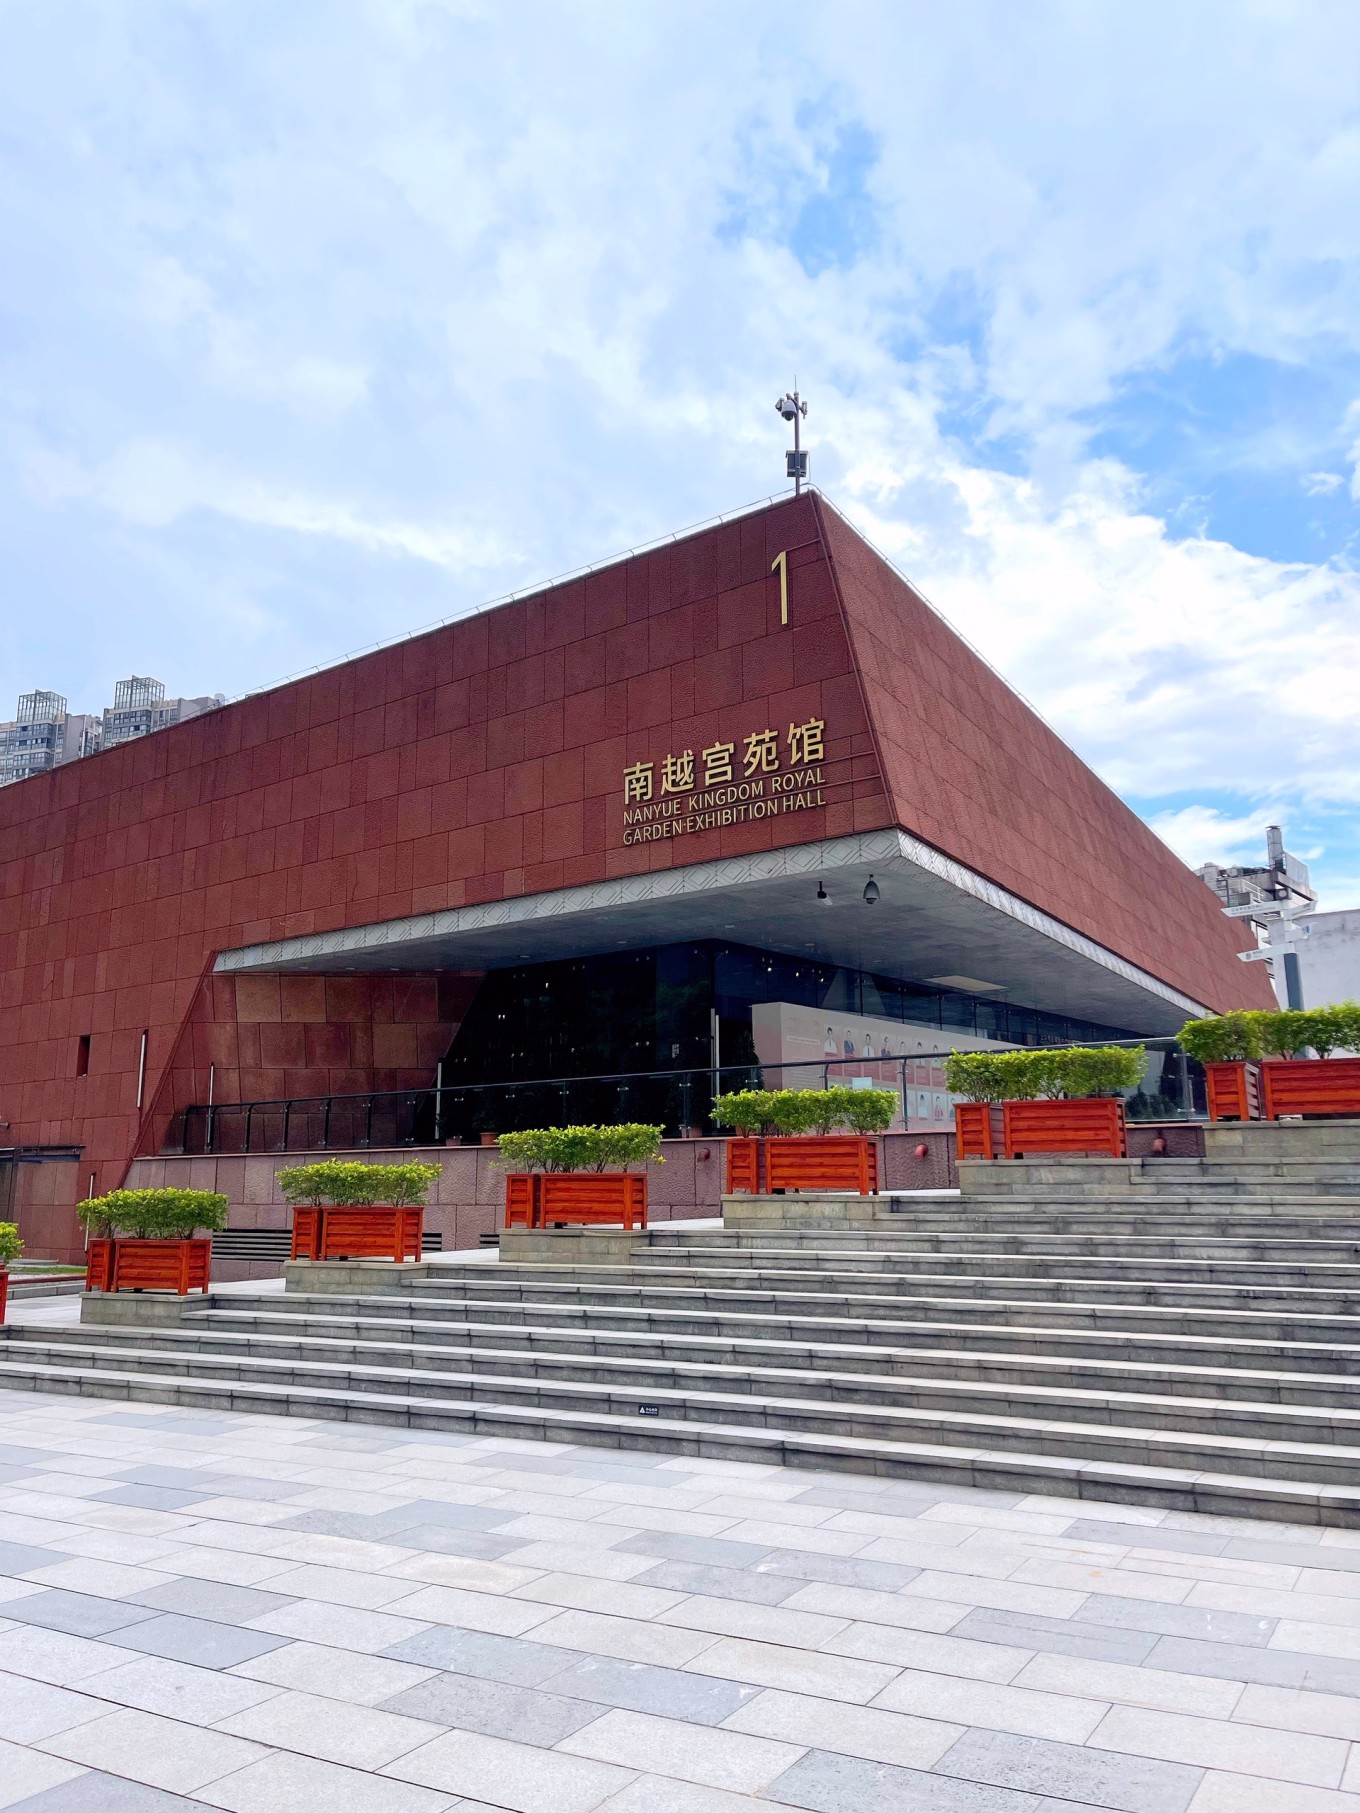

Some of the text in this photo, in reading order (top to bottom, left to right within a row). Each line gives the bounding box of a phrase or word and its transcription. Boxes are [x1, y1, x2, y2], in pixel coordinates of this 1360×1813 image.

[771, 551, 788, 625] 1
[623, 717, 825, 805] 南越宫苑馆
[623, 768, 826, 825] NANYUE KINGDOM ROYAL
[623, 789, 827, 845] GARDEN EXHIBITION HALL
